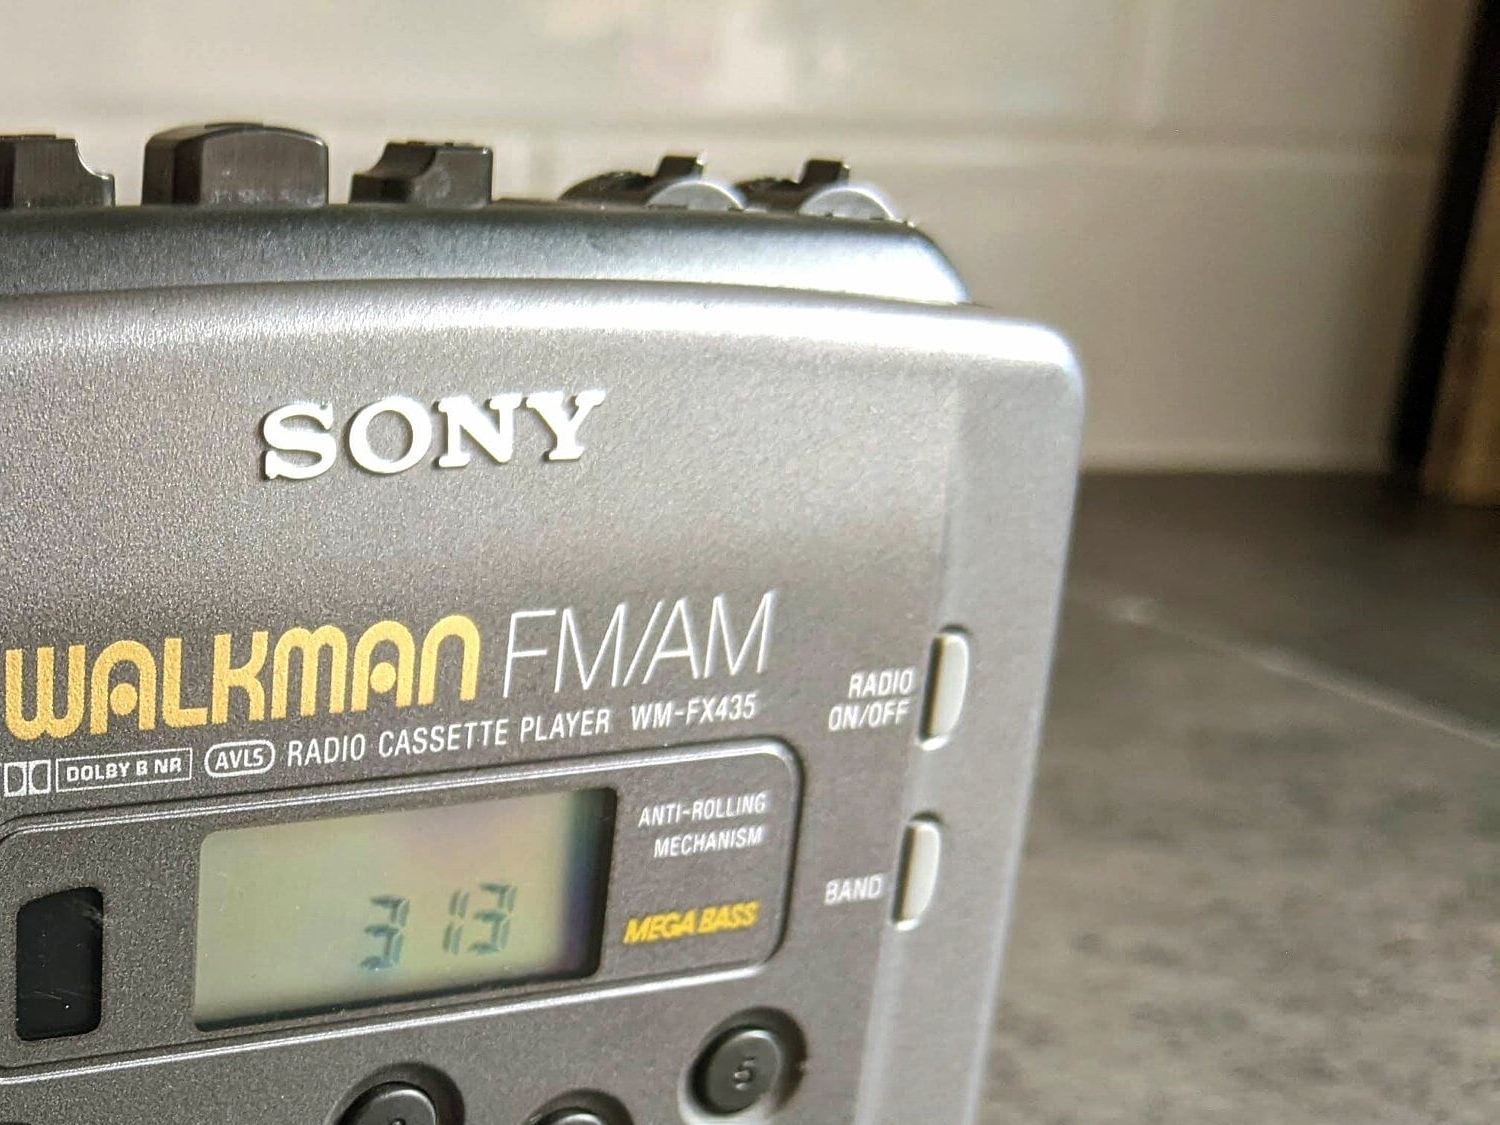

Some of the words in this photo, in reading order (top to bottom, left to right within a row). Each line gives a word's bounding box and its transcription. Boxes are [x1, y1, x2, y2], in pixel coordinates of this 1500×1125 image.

[263, 389, 605, 480] SONY
[503, 590, 777, 698] FM/AM
[848, 668, 915, 696] RADIO
[287, 734, 365, 766] RADIO
[378, 718, 508, 758] CASSETTE
[519, 708, 611, 743] PLAYER
[631, 693, 757, 731] WM-FX435
[828, 701, 909, 731] ON/OFF
[66, 762, 130, 782] DOLBY
[136, 761, 148, 777] B
[154, 757, 182, 774] NR
[214, 747, 265, 771] AVLS
[638, 791, 767, 827] ANTI-ROLLING
[653, 827, 763, 859] MECHANISM
[824, 873, 882, 904] BAND
[623, 909, 696, 944] MEGA
[699, 901, 761, 932] BASS
[732, 1056, 756, 1091] 5
